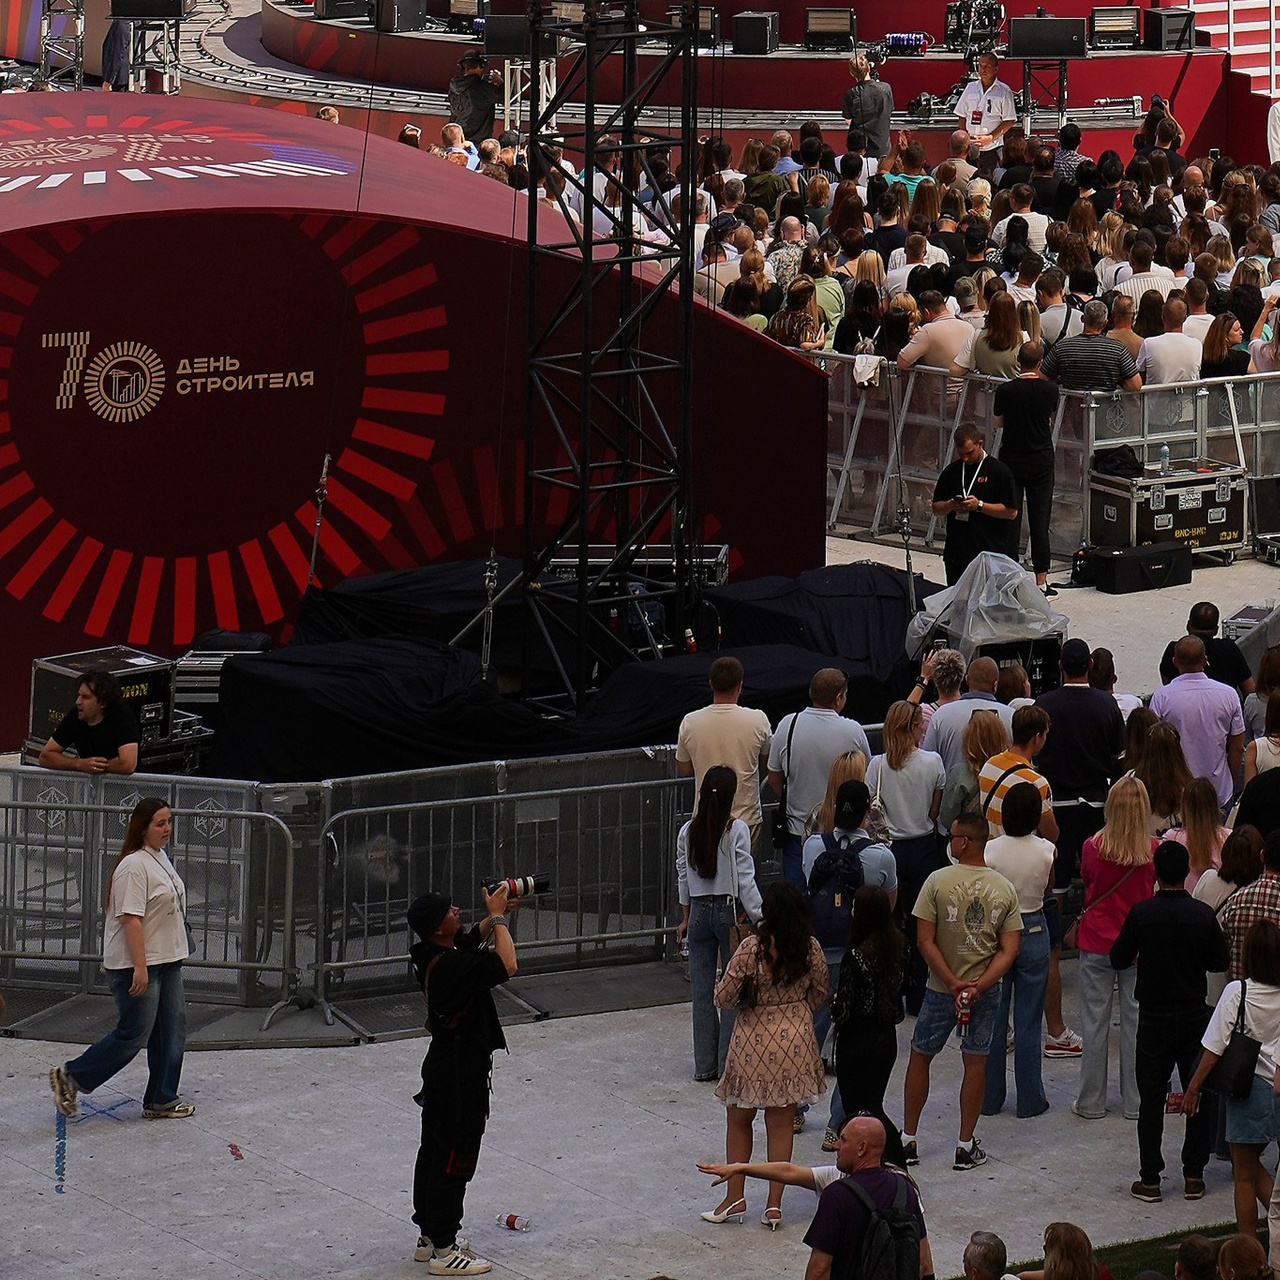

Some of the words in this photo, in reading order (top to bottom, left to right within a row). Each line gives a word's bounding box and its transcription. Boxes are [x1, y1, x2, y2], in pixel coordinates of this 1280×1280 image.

[42, 331, 165, 423] 70
[176, 356, 240, 374] ДЕНЬ
[176, 371, 314, 395] СТРОИТЕЛЯ
